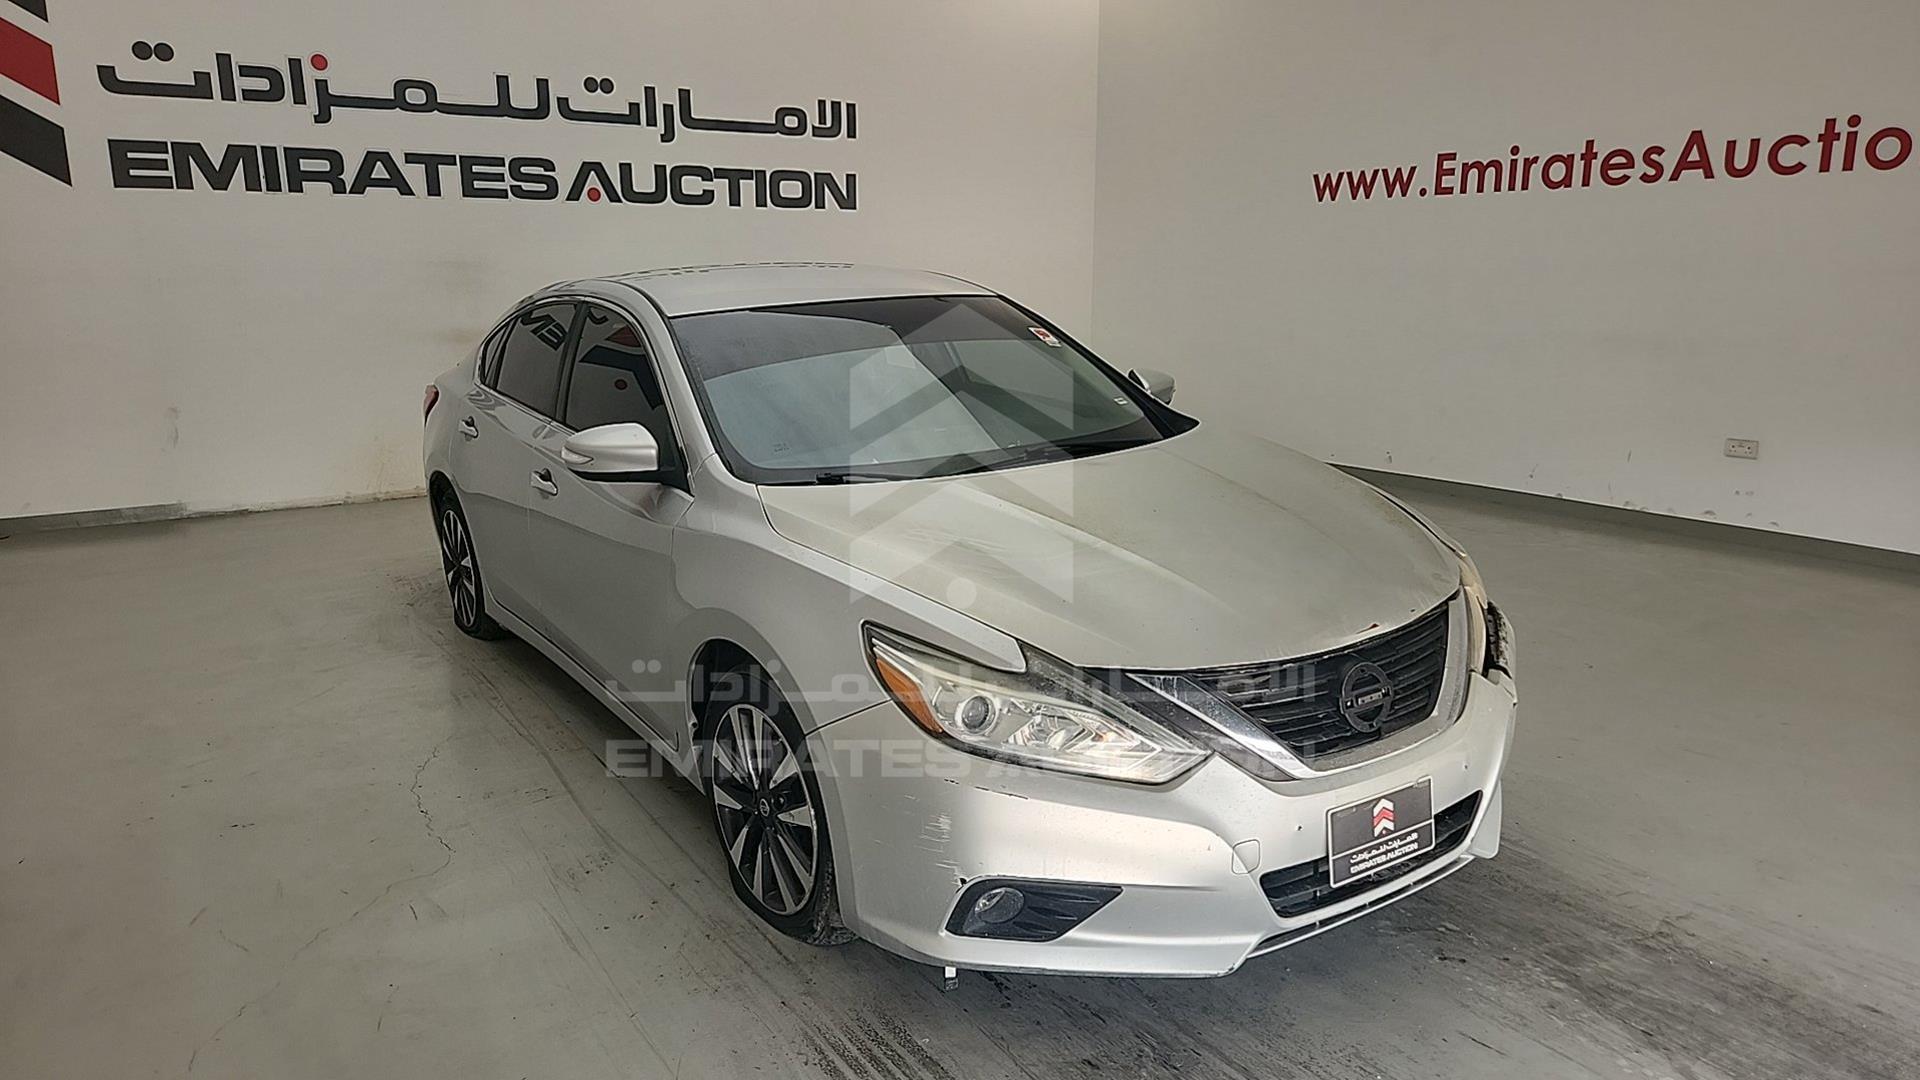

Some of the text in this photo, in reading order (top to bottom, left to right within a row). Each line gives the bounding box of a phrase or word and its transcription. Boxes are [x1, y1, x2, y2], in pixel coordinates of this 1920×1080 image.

[95, 41, 857, 143] الامارات للمزادات
[107, 138, 857, 211] EMIRATES AUCTION
[1386, 841, 1419, 860] AUCTION
